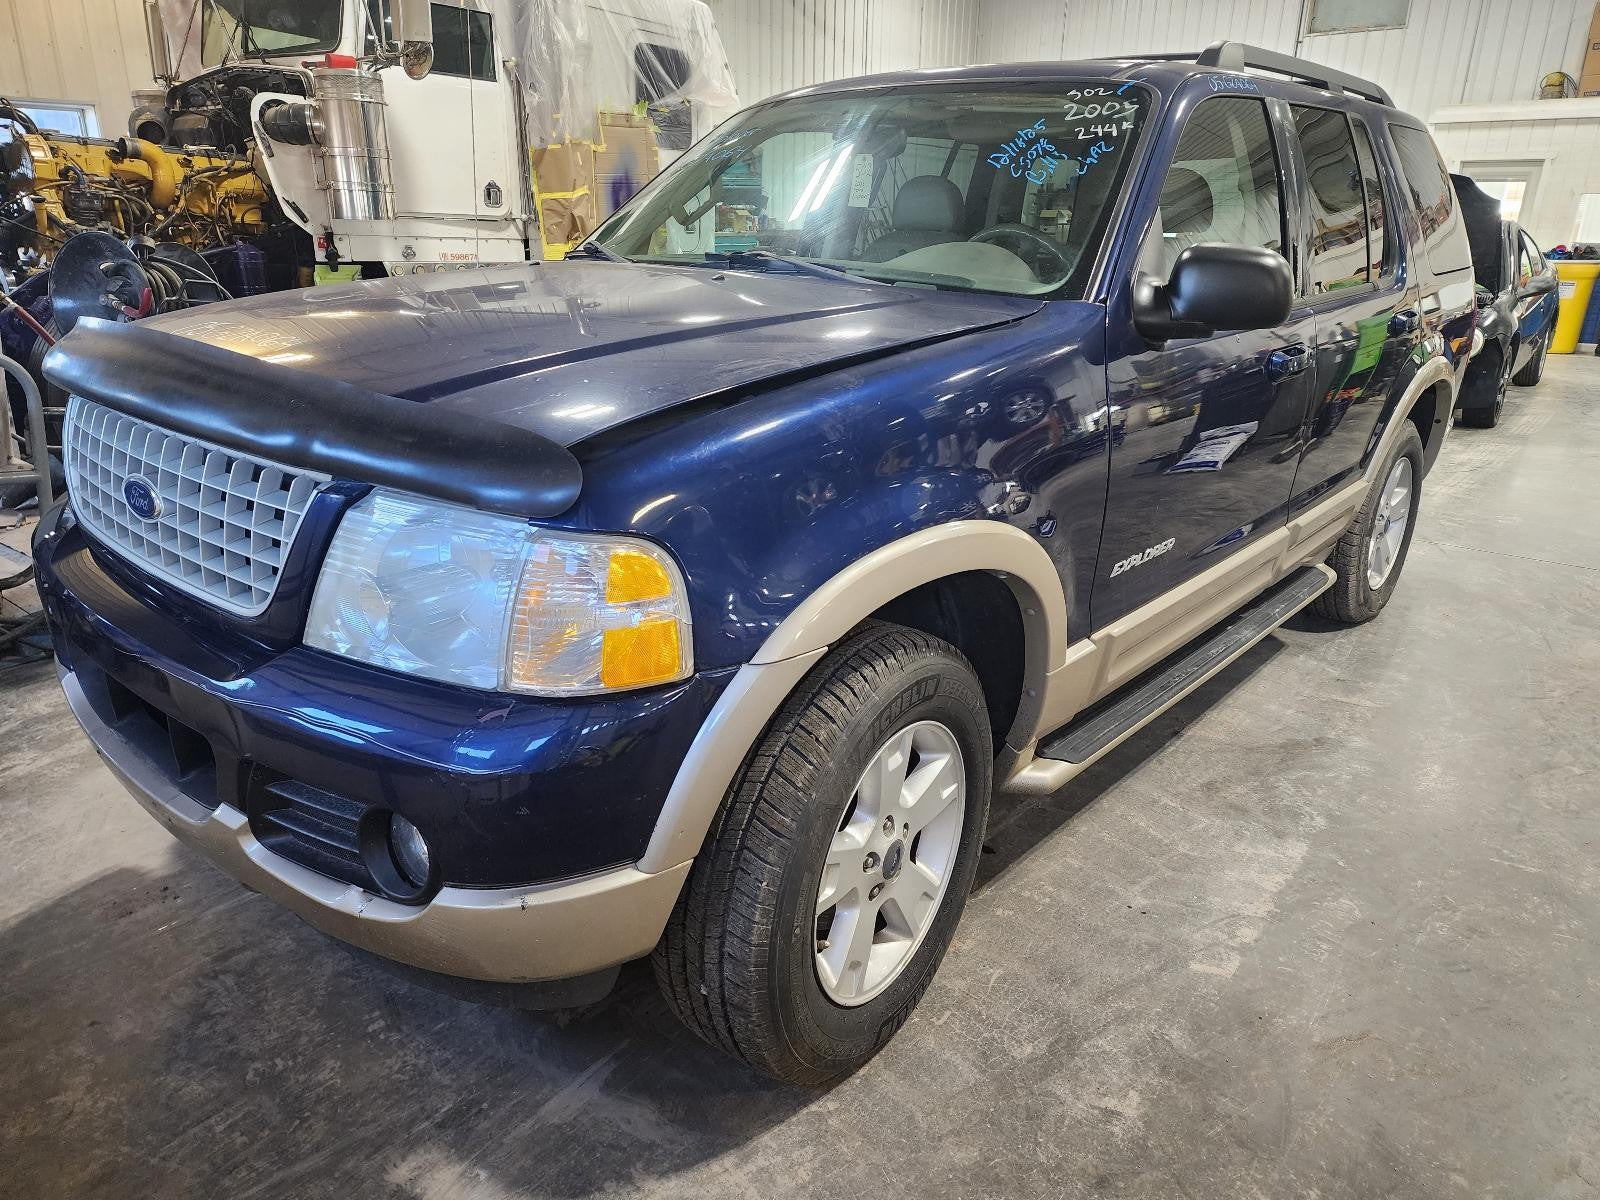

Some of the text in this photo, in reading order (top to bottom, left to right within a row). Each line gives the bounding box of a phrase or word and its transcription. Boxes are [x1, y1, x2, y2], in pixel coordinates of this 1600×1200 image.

[1063, 98, 1139, 121] 2005
[131, 485, 149, 511] Ford
[1109, 537, 1176, 578] EXPLORER
